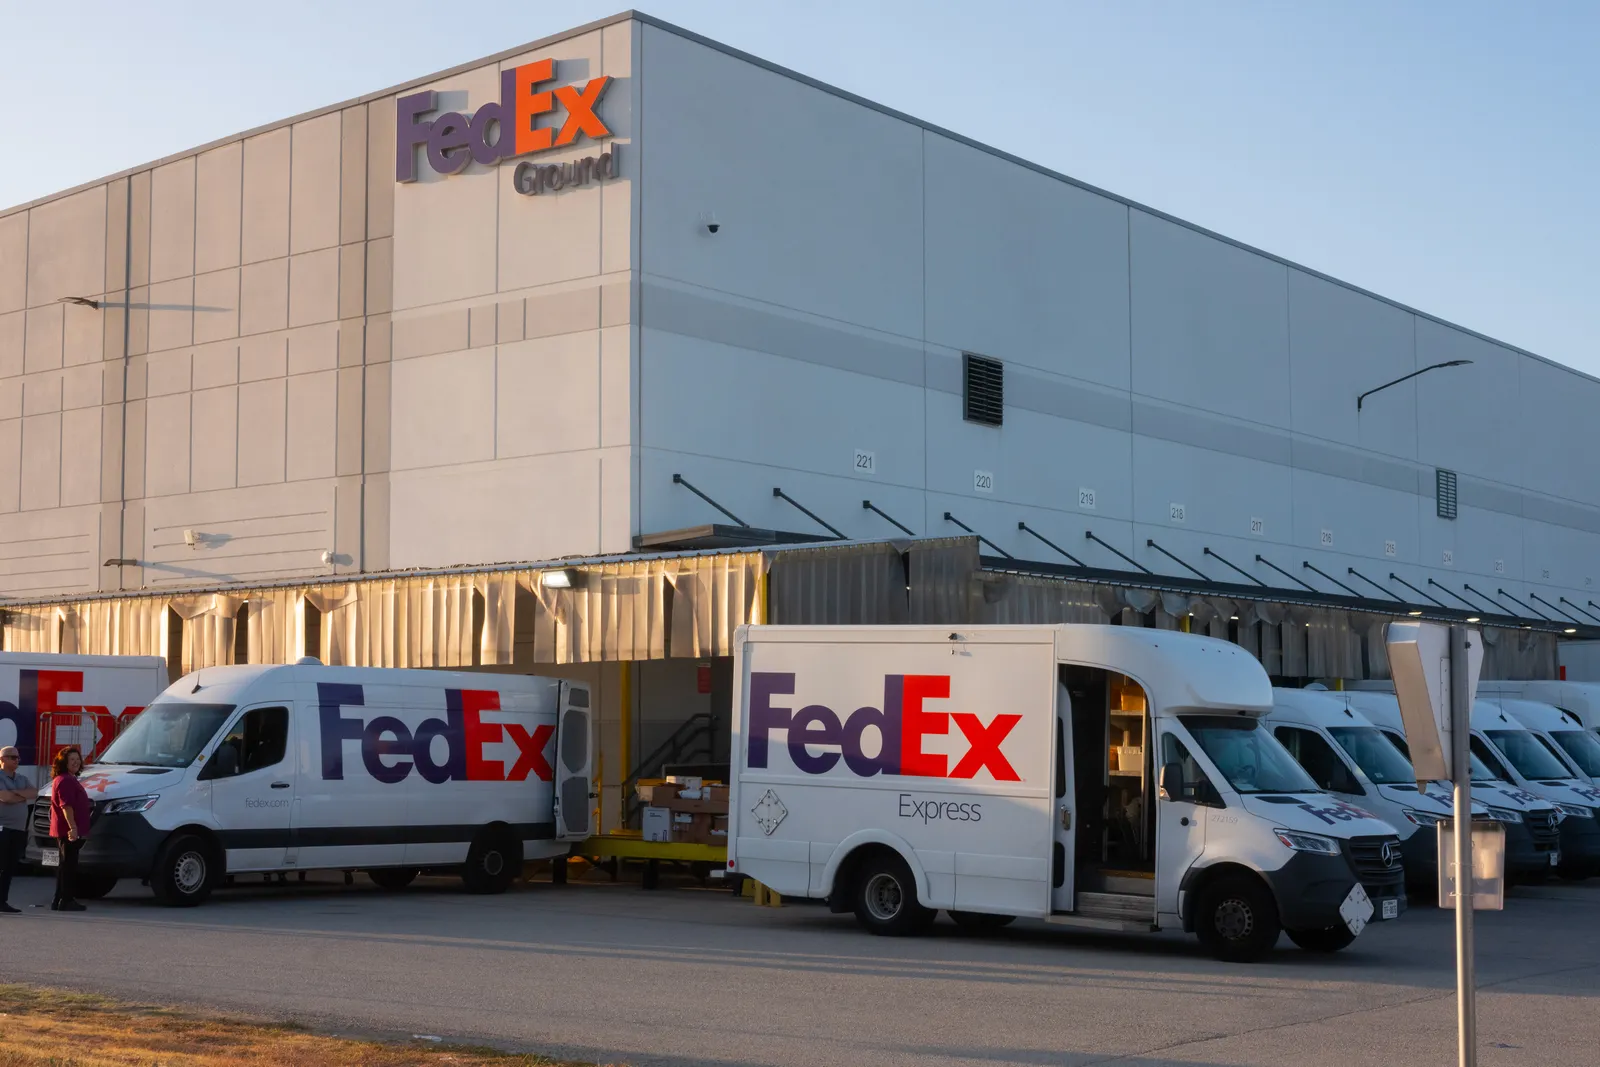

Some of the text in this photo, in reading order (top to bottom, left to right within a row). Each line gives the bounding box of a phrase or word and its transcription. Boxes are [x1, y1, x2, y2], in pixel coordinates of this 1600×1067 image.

[396, 58, 613, 183] FedEx
[513, 142, 619, 196] Ground
[856, 454, 872, 469] 221
[976, 474, 991, 489] 220
[1080, 492, 1094, 505] 219
[1171, 507, 1184, 520] 218
[1251, 520, 1262, 532] 217
[316, 682, 556, 784] FedEx
[747, 672, 1024, 782] FedEx
[245, 797, 289, 808] fedex.com
[898, 793, 982, 825] Express
